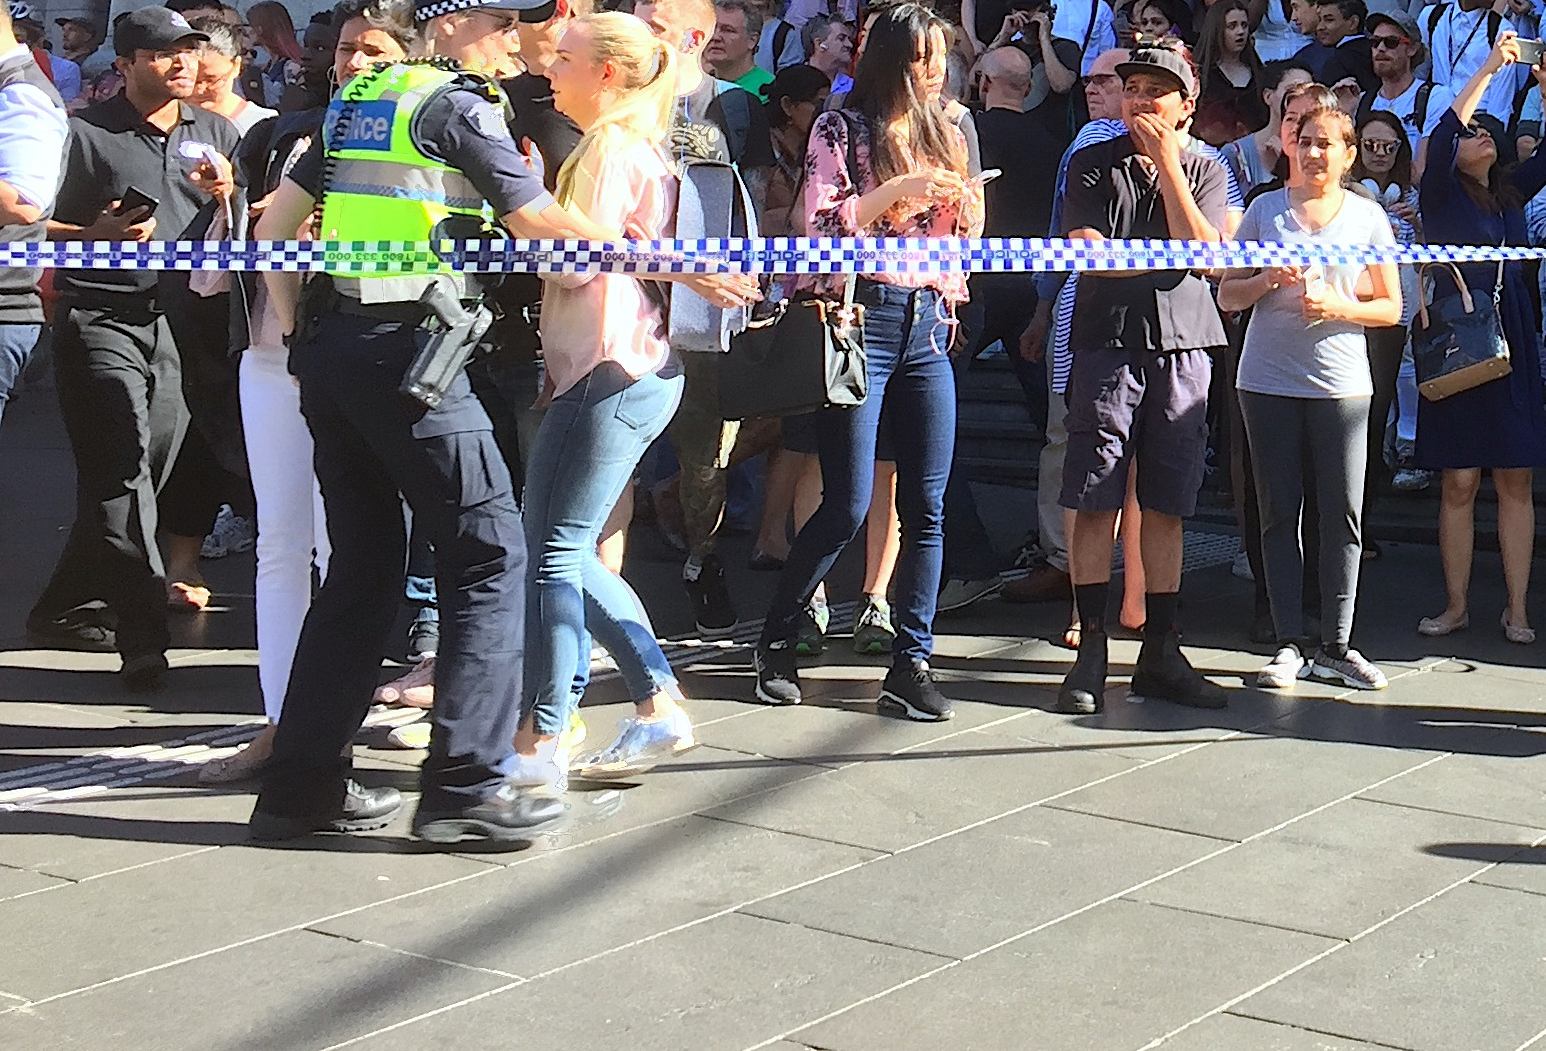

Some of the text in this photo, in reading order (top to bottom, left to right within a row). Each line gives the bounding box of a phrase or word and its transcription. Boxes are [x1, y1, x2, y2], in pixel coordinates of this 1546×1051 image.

[328, 253, 411, 261] 1800 333 000
[604, 253, 626, 261] 000
[629, 253, 650, 261] 333
[745, 251, 806, 261] POLICE
[856, 251, 876, 259] 000
[879, 251, 897, 259] 333
[985, 250, 1041, 259] POLICE
